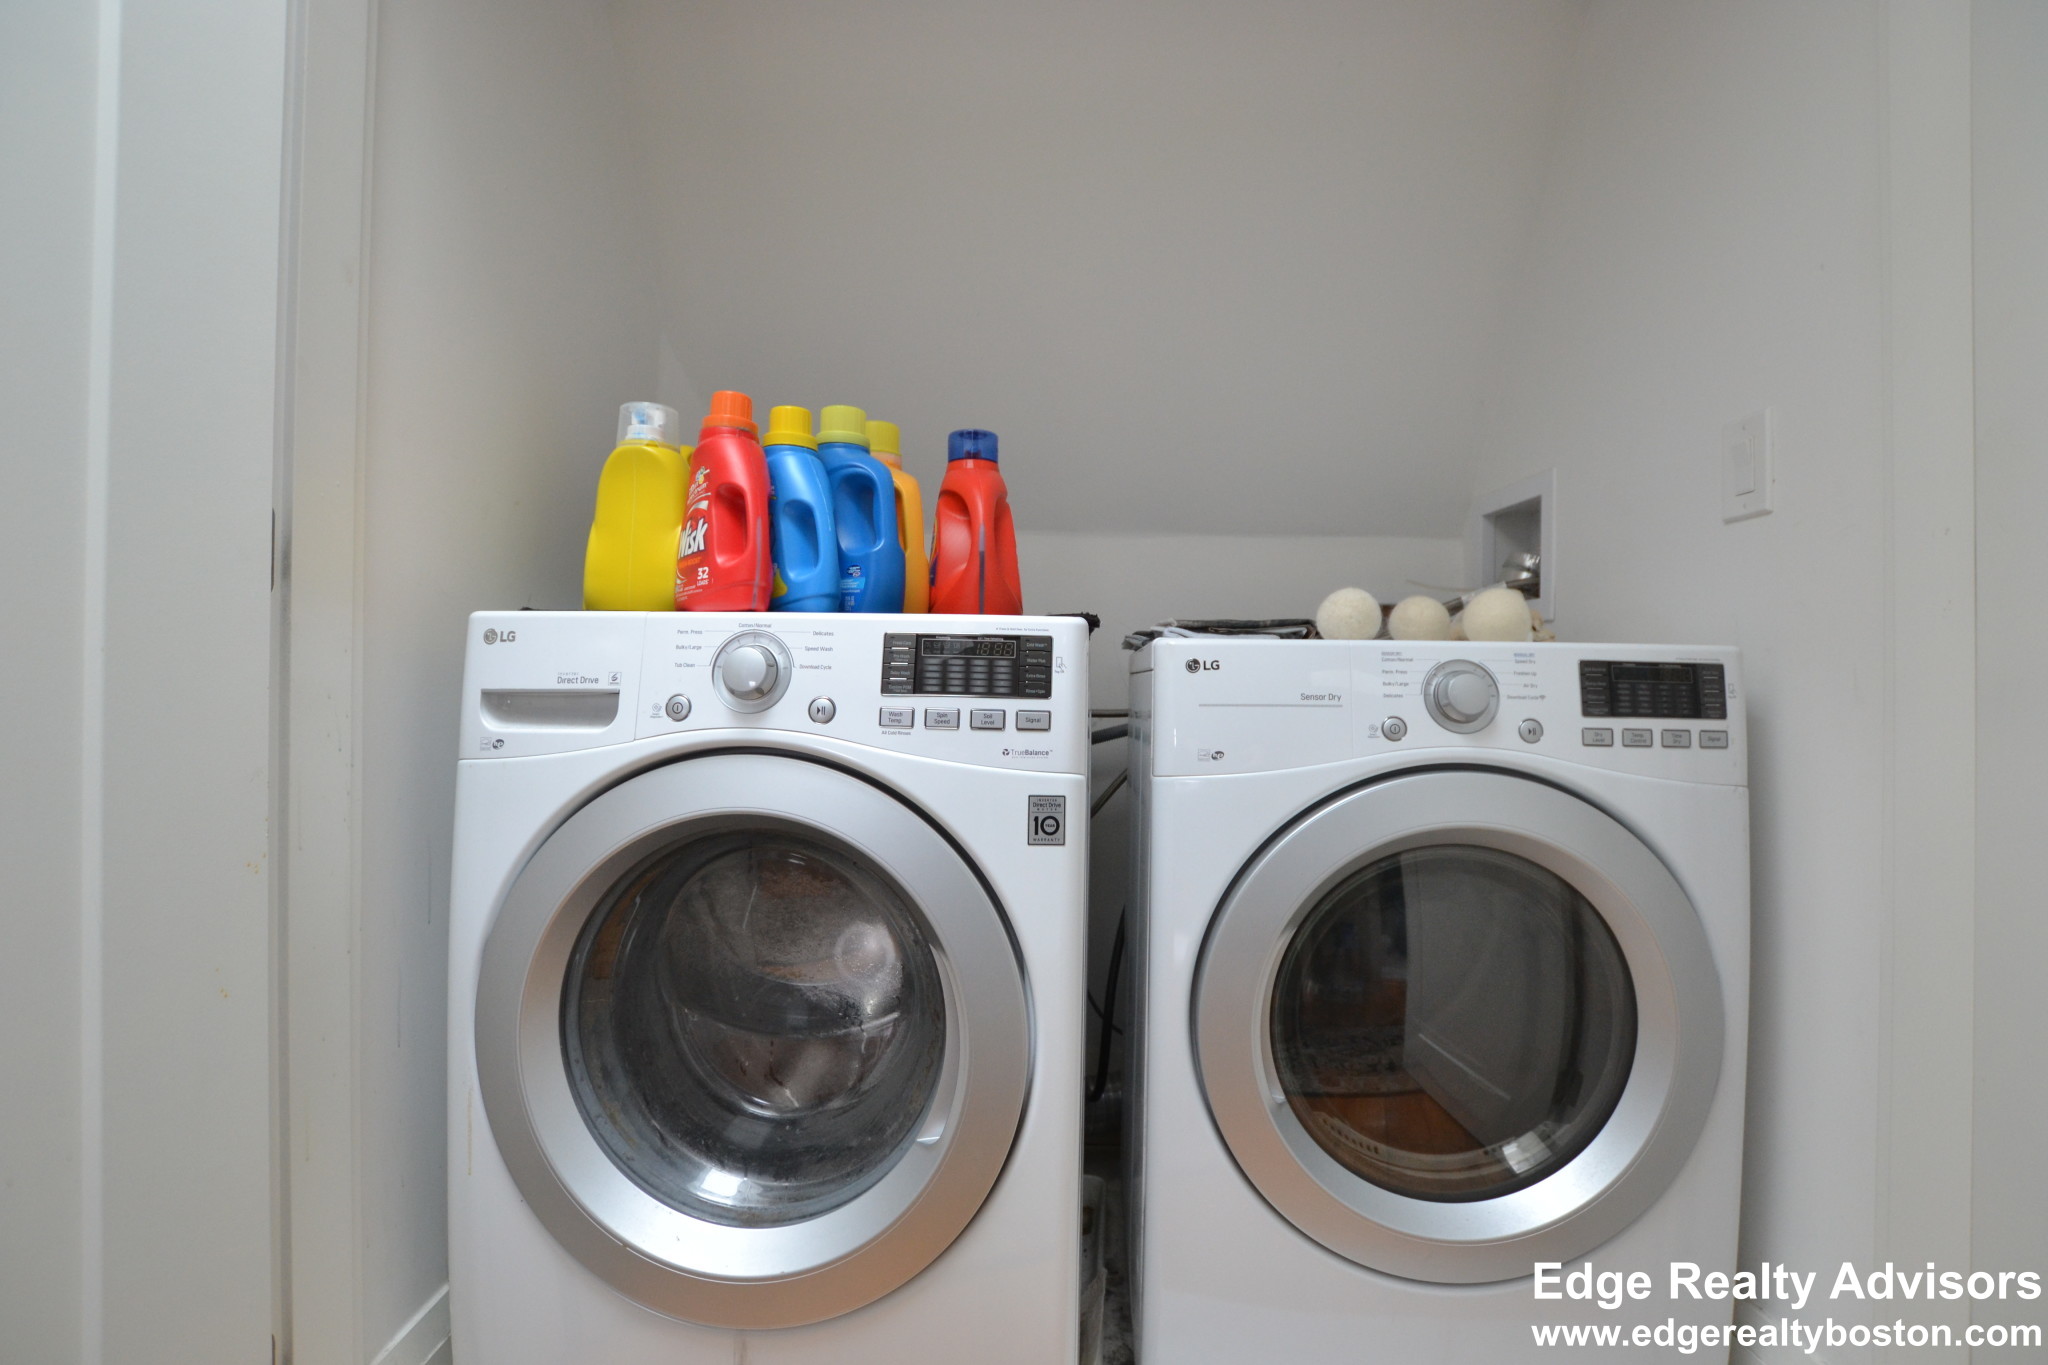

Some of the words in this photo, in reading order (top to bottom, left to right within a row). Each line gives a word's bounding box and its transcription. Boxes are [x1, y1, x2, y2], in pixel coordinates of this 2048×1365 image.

[679, 517, 708, 559] Wisk
[697, 566, 709, 580] 32
[500, 630, 516, 642] LG
[1203, 660, 1220, 671] LG
[557, 676, 578, 684] Direct
[580, 676, 599, 684] Drive
[1300, 692, 1327, 701] Sensor
[1328, 693, 1342, 703] Dry
[1034, 815, 1060, 836] 10
